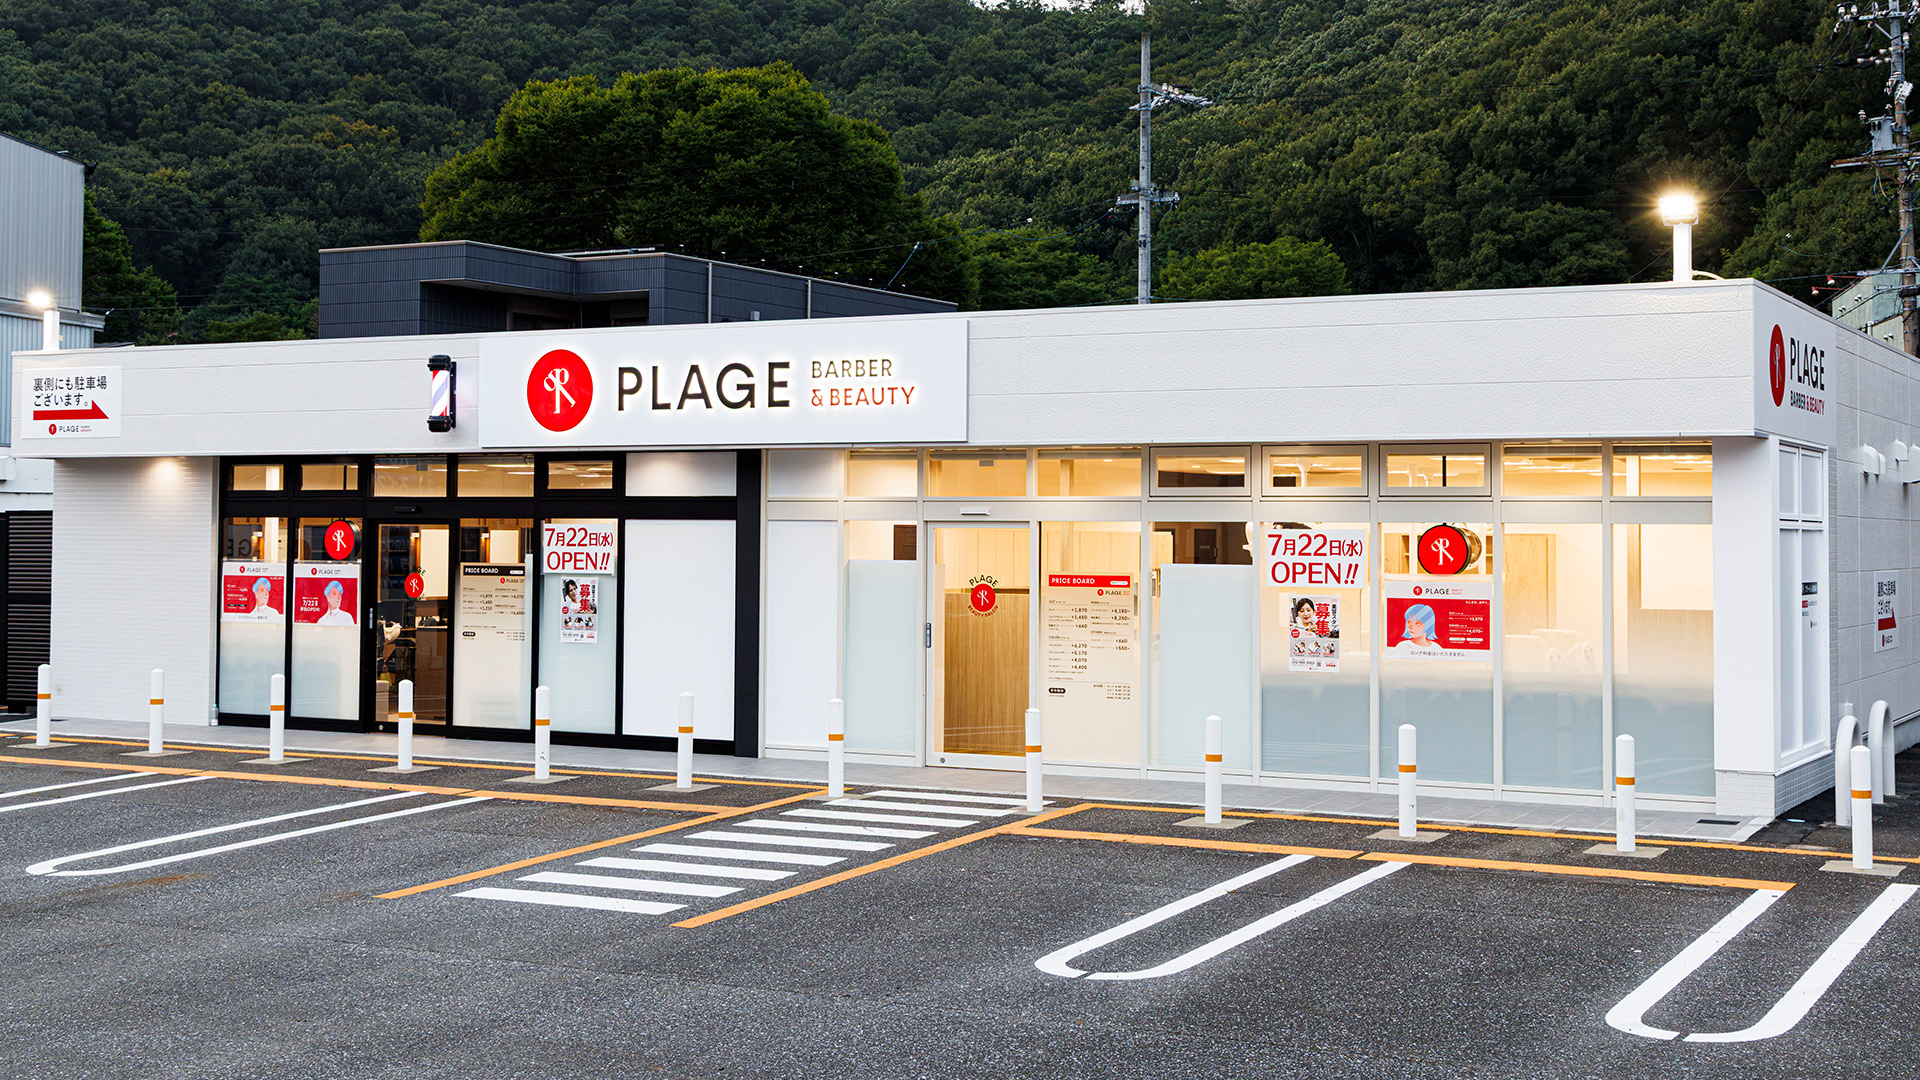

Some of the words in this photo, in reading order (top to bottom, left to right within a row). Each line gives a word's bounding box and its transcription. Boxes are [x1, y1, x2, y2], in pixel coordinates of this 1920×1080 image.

[811, 358, 892, 380] BARBER
[1790, 337, 1825, 391] PLAGE
[33, 376, 107, 391] 裏側にも駐車場
[617, 361, 790, 412] PLAGE
[34, 392, 88, 407] ございます。
[811, 388, 824, 407] &
[830, 385, 915, 406] BEAUTY
[1790, 390, 1806, 410] BARBER
[1810, 396, 1825, 415] BEAUTY
[59, 425, 79, 433] PLAGE
[545, 527, 614, 547] 7月22日(水)
[1267, 533, 1363, 557] 7月22日(水)
[547, 551, 610, 571] OPEN!!
[968, 574, 999, 587] PLAGE
[1271, 561, 1359, 585] OPEN!!
[580, 584, 591, 612] 募集
[1425, 587, 1450, 595] PLAGE
[1315, 602, 1330, 636] 募集
